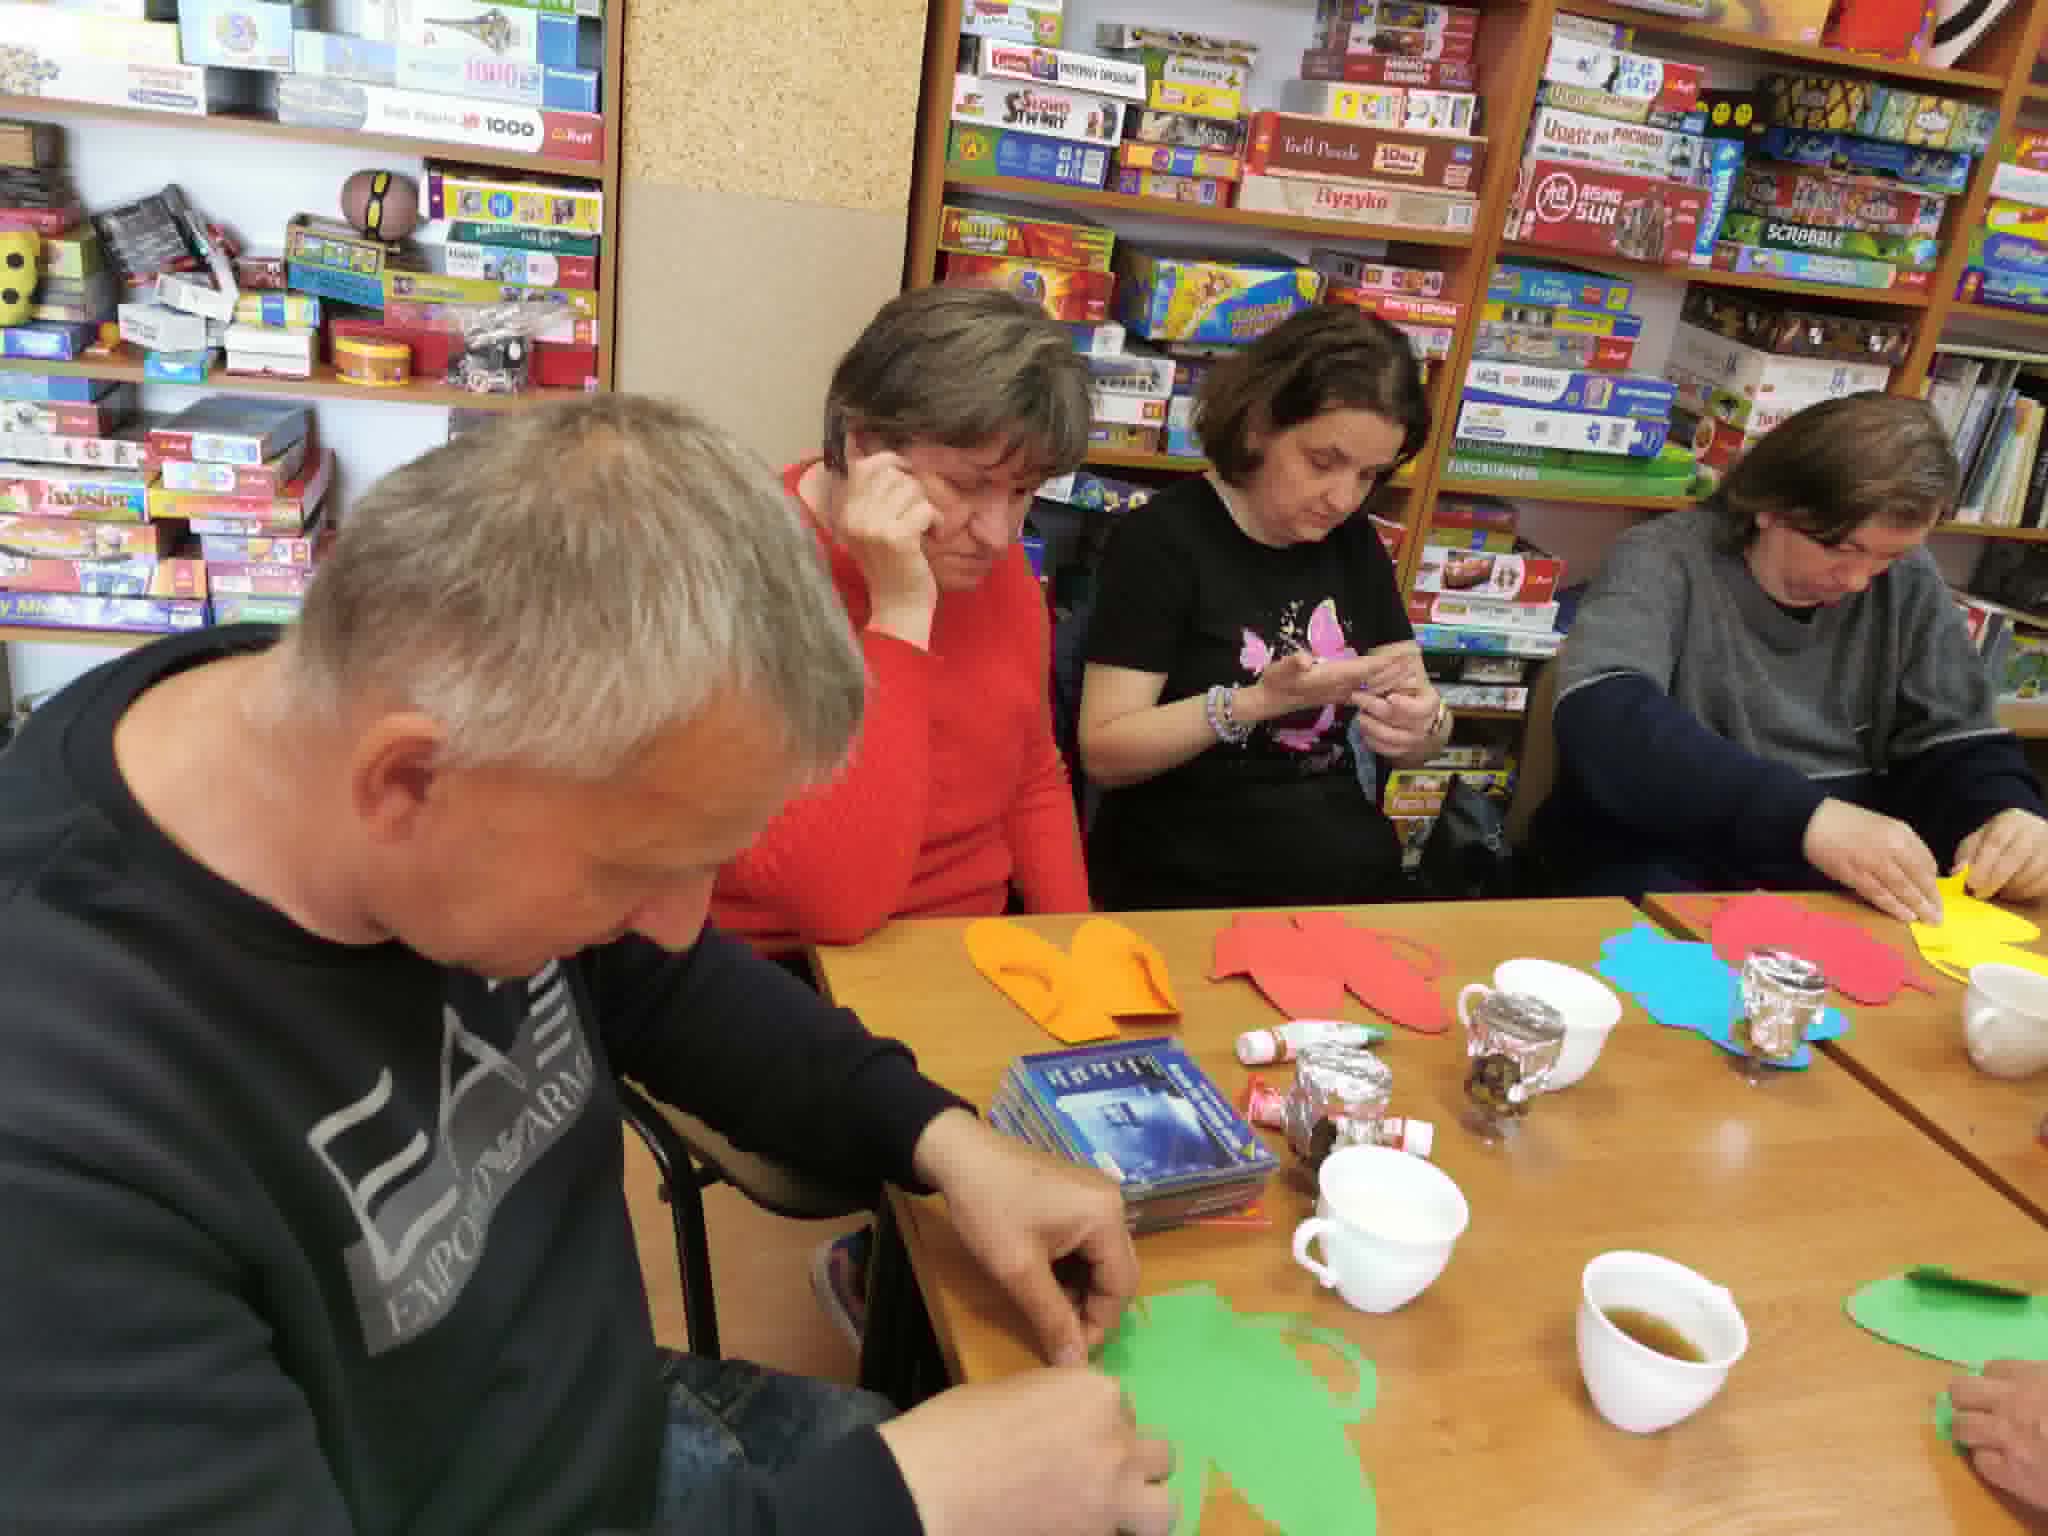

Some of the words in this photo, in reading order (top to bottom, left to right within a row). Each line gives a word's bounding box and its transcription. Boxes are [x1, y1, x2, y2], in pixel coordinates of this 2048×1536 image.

[486, 116, 535, 137] 1000
[1579, 184, 1624, 203] RISING
[1575, 202, 1618, 225] SUN
[1767, 223, 1845, 249] SCRABBLE
